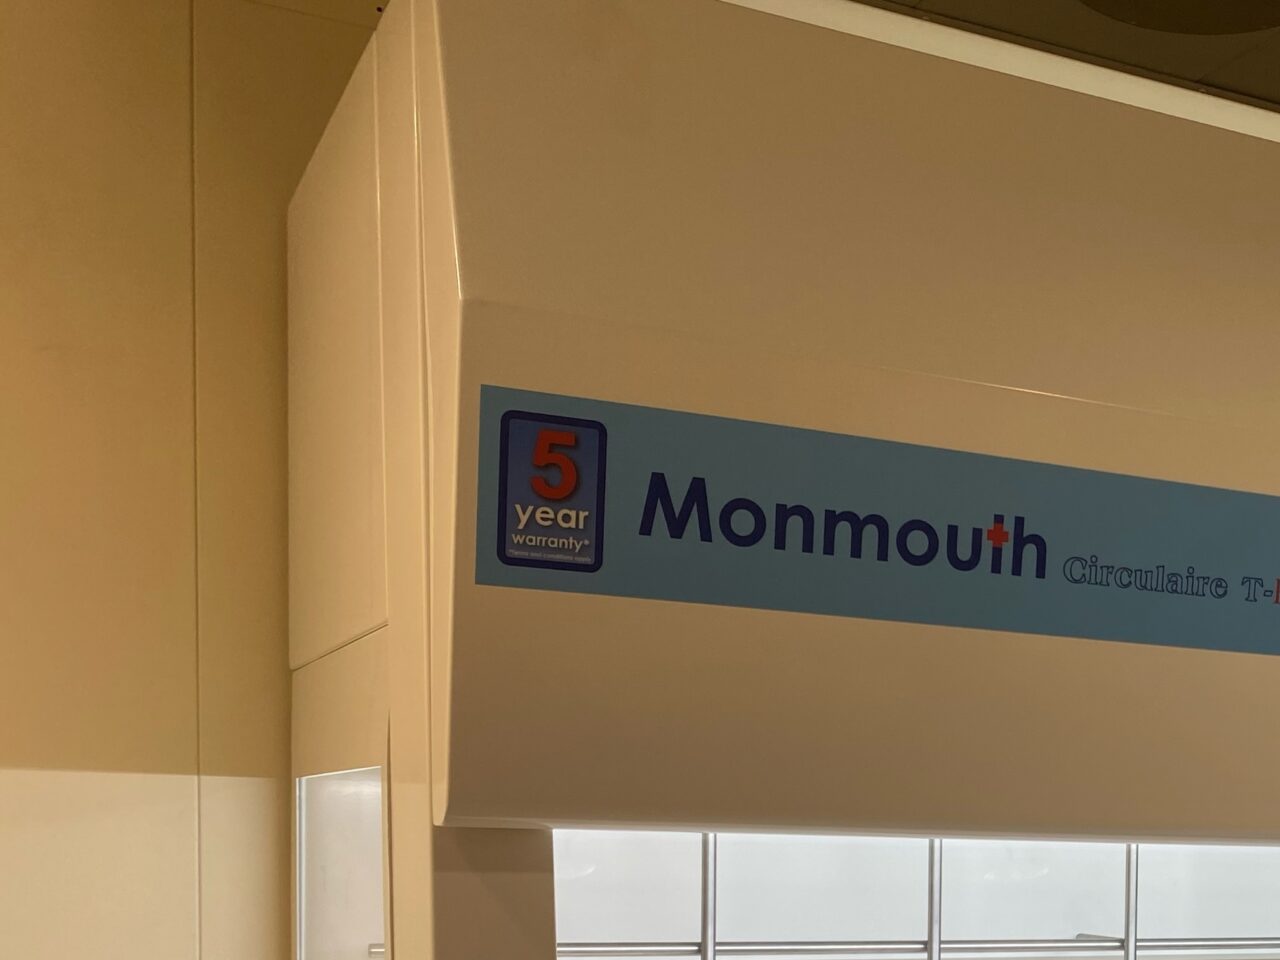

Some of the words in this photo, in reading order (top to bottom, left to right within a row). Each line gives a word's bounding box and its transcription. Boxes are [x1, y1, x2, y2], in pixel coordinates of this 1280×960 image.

[530, 429, 578, 500] 5
[514, 504, 588, 529] year
[639, 472, 1047, 579] Monmouth
[1062, 555, 1229, 599] Circulaire
